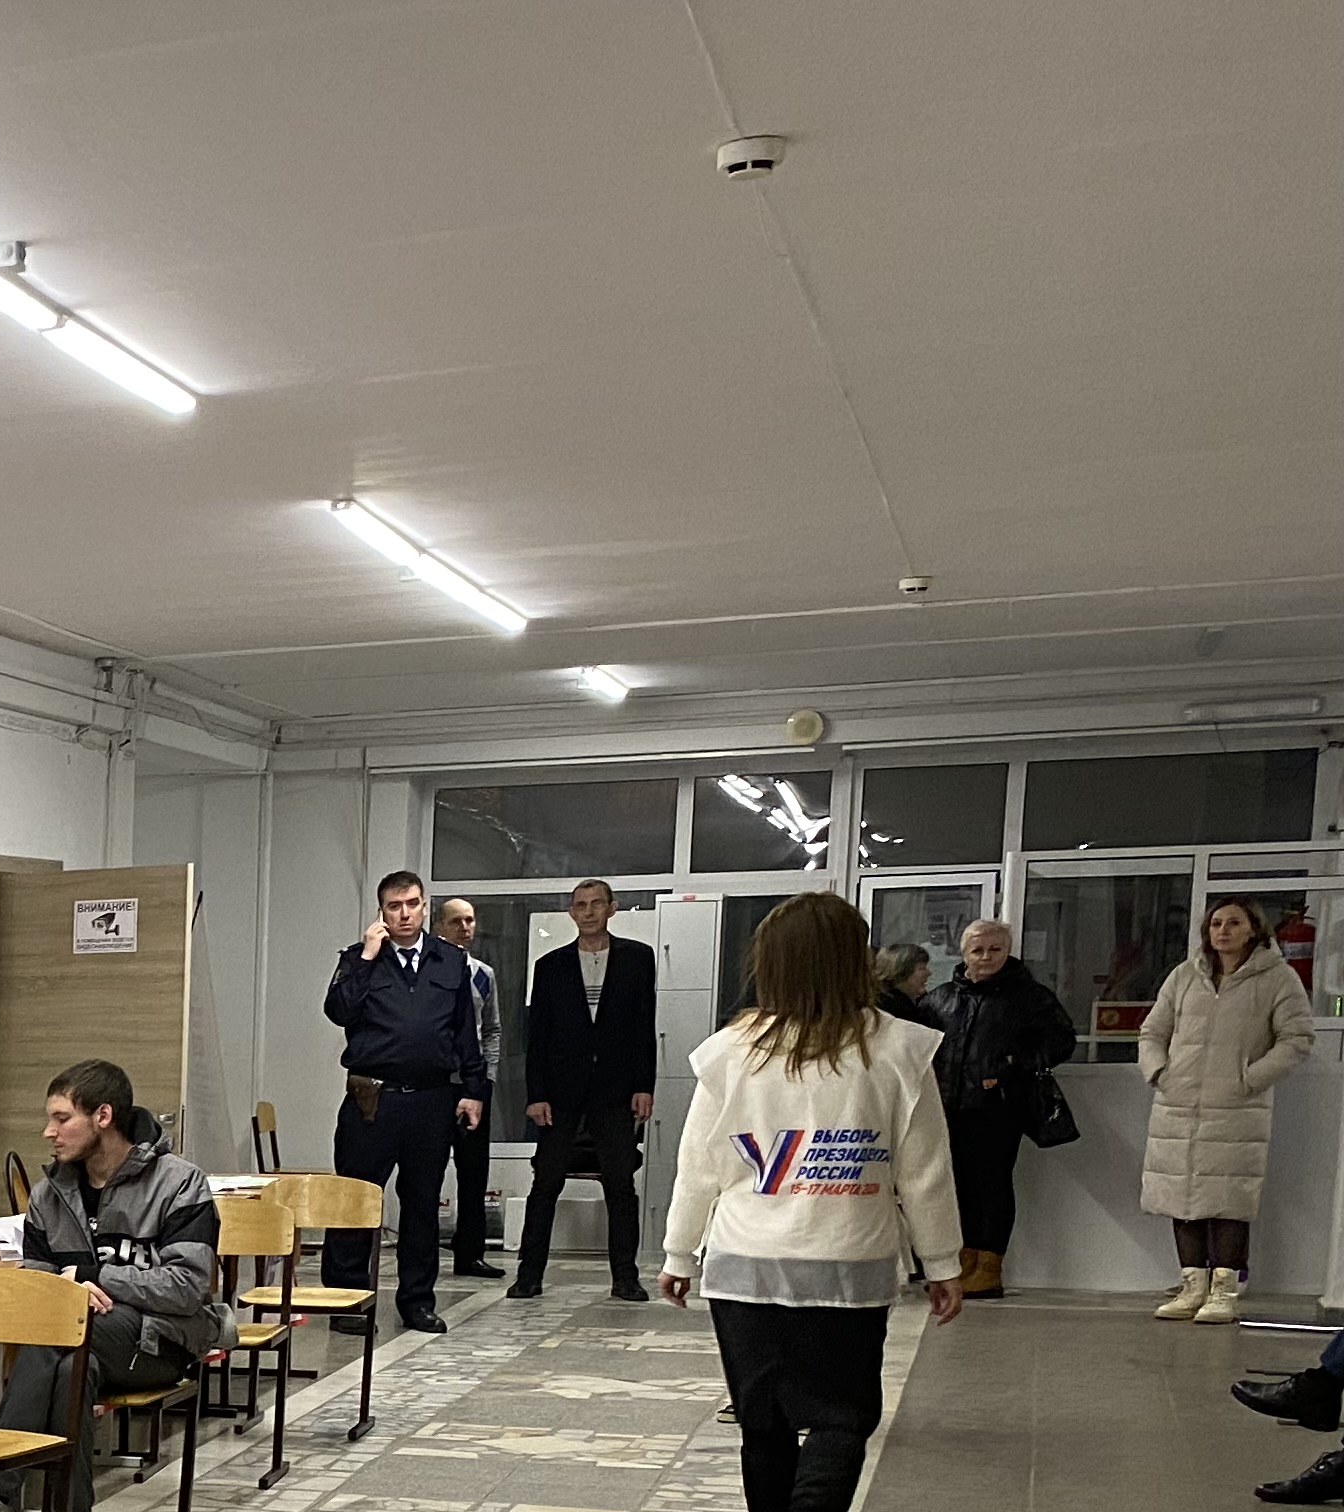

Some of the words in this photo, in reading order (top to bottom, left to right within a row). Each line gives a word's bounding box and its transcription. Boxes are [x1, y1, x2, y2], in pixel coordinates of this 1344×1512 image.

[77, 901, 135, 913] ВНИМАНИЕ!
[812, 1129, 881, 1143] ВЫБОРЫ
[796, 1166, 863, 1180] РОССИИ
